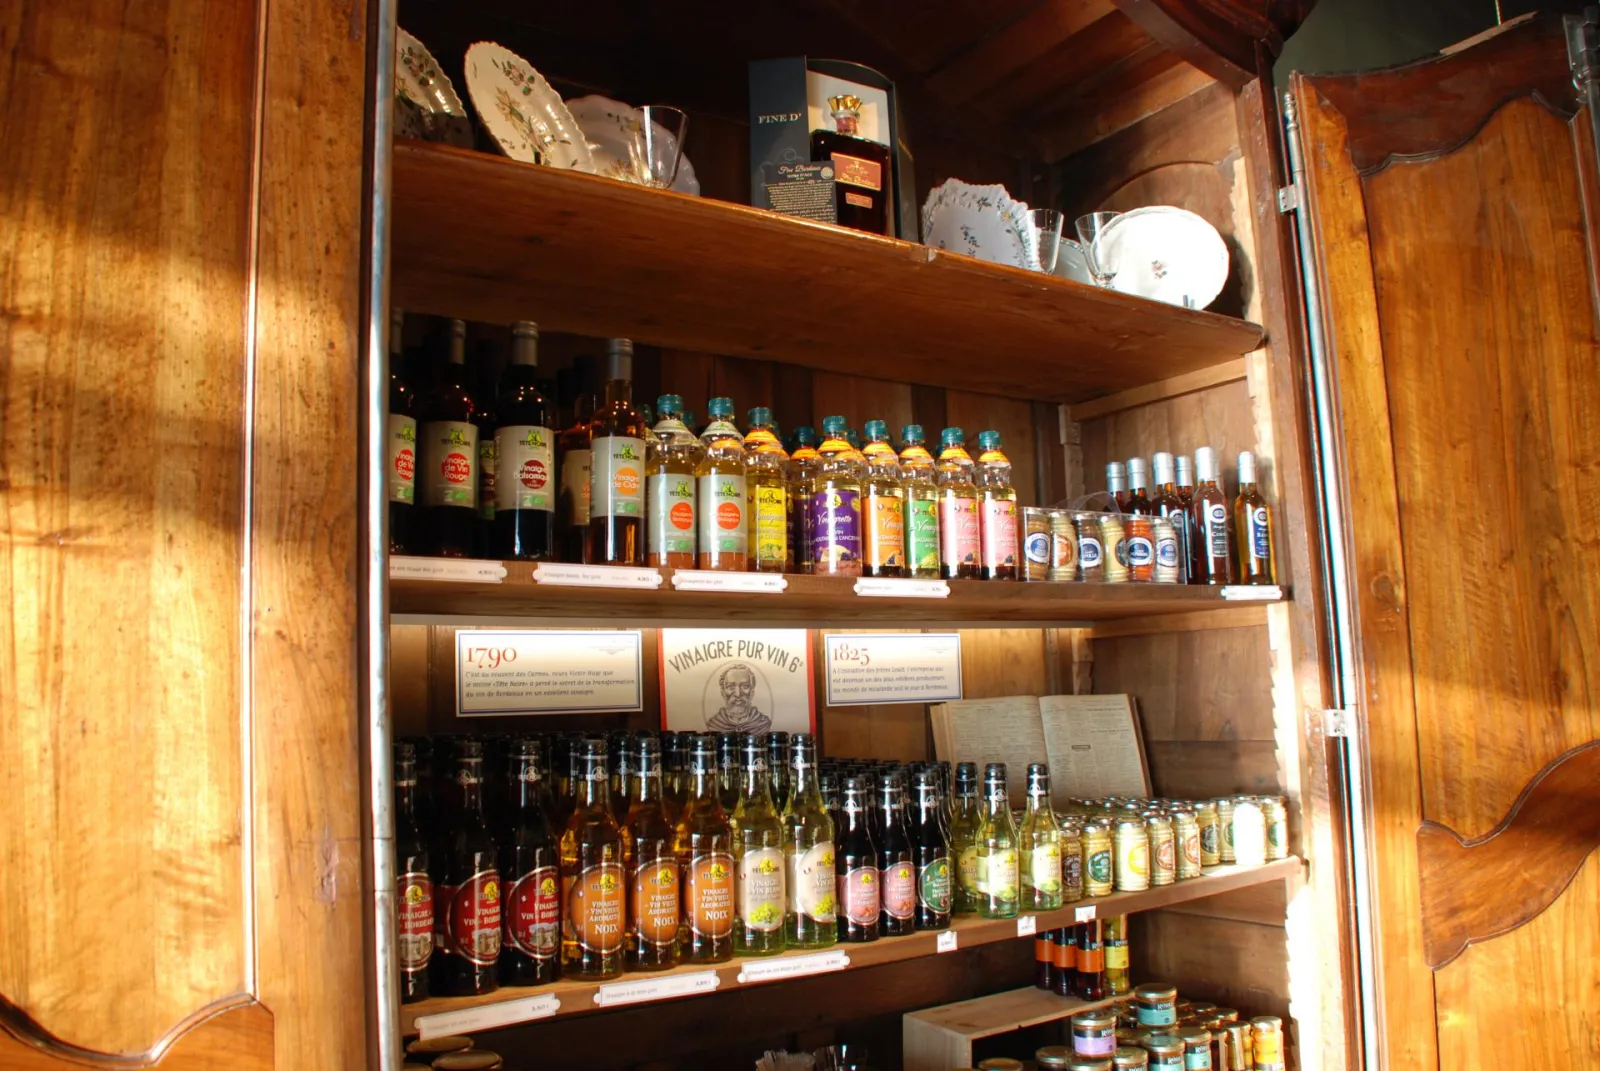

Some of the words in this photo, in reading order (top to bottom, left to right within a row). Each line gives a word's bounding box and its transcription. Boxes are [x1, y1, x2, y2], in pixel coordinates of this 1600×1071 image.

[758, 114, 787, 124] FINE
[465, 647, 518, 669] 1790
[669, 640, 733, 674] VINAIGRE
[738, 640, 764, 660] PUR
[767, 644, 789, 668] VIN
[833, 643, 870, 666] 1825
[521, 911, 535, 920] VIN
[705, 910, 728, 921] NOIX
[463, 917, 477, 926] VIN
[653, 917, 676, 927] NOIX
[594, 924, 618, 934] NOIX
